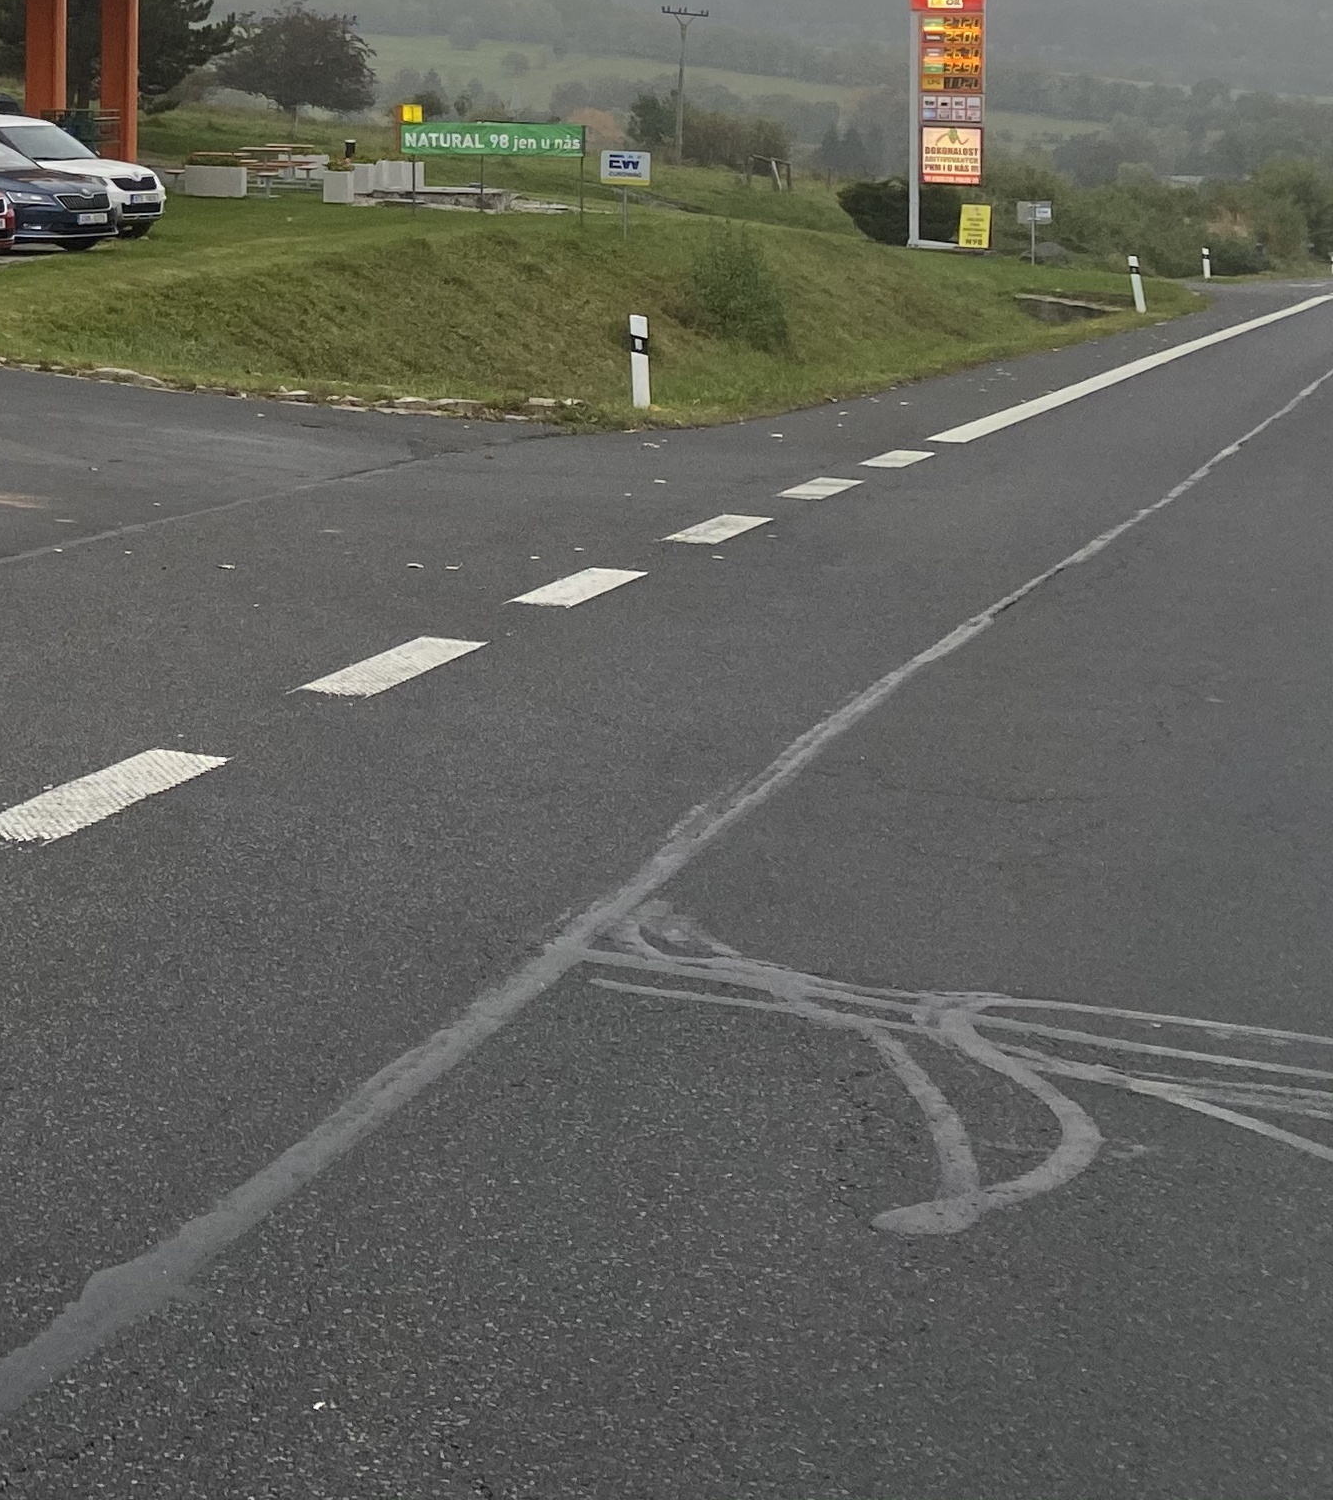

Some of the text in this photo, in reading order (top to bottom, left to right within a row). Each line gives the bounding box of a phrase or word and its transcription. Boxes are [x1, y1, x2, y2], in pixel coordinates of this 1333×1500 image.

[405, 132, 580, 152] NATURAL 98 jen u nás
[925, 147, 978, 156] DOKONALOST
